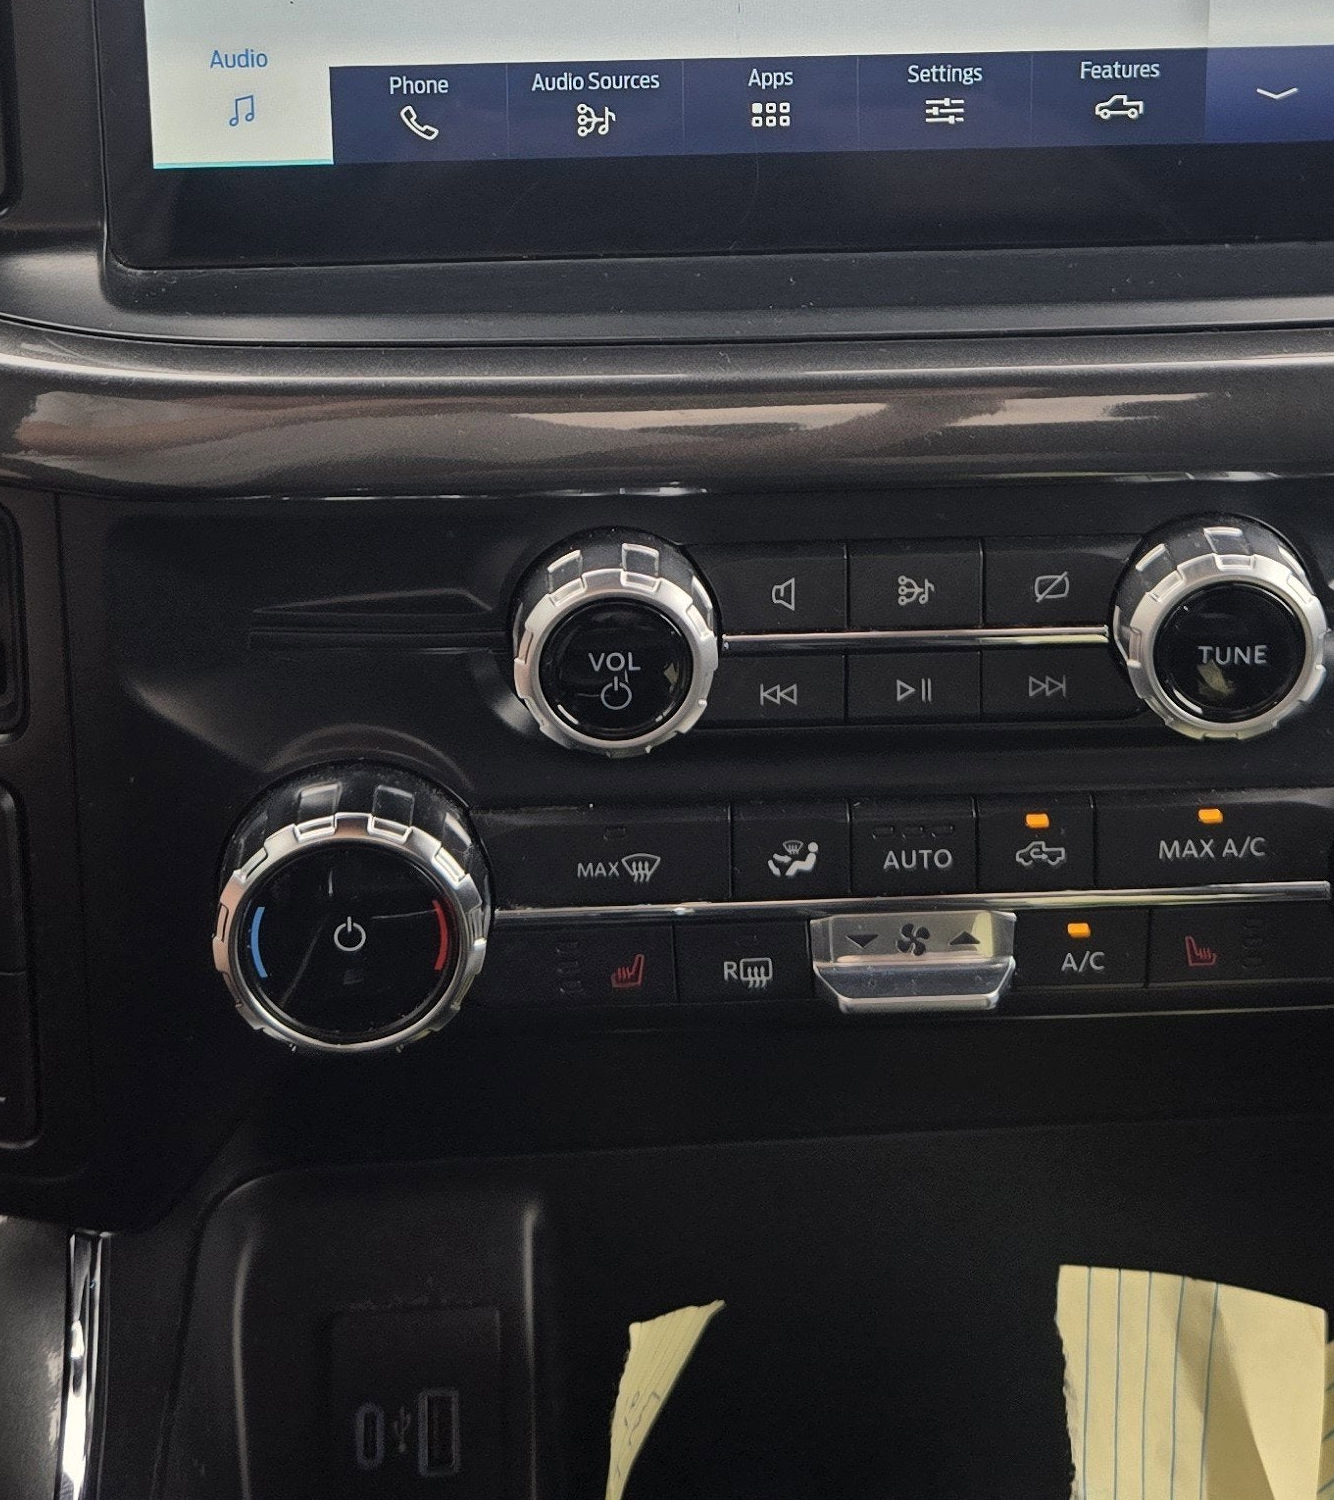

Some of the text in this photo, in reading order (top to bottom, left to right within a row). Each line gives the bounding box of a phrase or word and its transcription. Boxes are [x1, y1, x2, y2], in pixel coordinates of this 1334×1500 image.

[210, 49, 268, 70] Audio
[748, 69, 793, 91] Apps
[908, 65, 983, 86] Settings
[1080, 62, 1160, 80] Features
[389, 76, 449, 96] Phone
[531, 72, 660, 92] Audio Sources
[588, 652, 641, 672] VOL
[1198, 645, 1267, 666] TUNE
[1158, 837, 1265, 861] MAX A/C
[577, 862, 620, 878] MAX
[883, 849, 953, 871] AUTO
[723, 962, 738, 982] R
[1061, 951, 1104, 974] A/C
